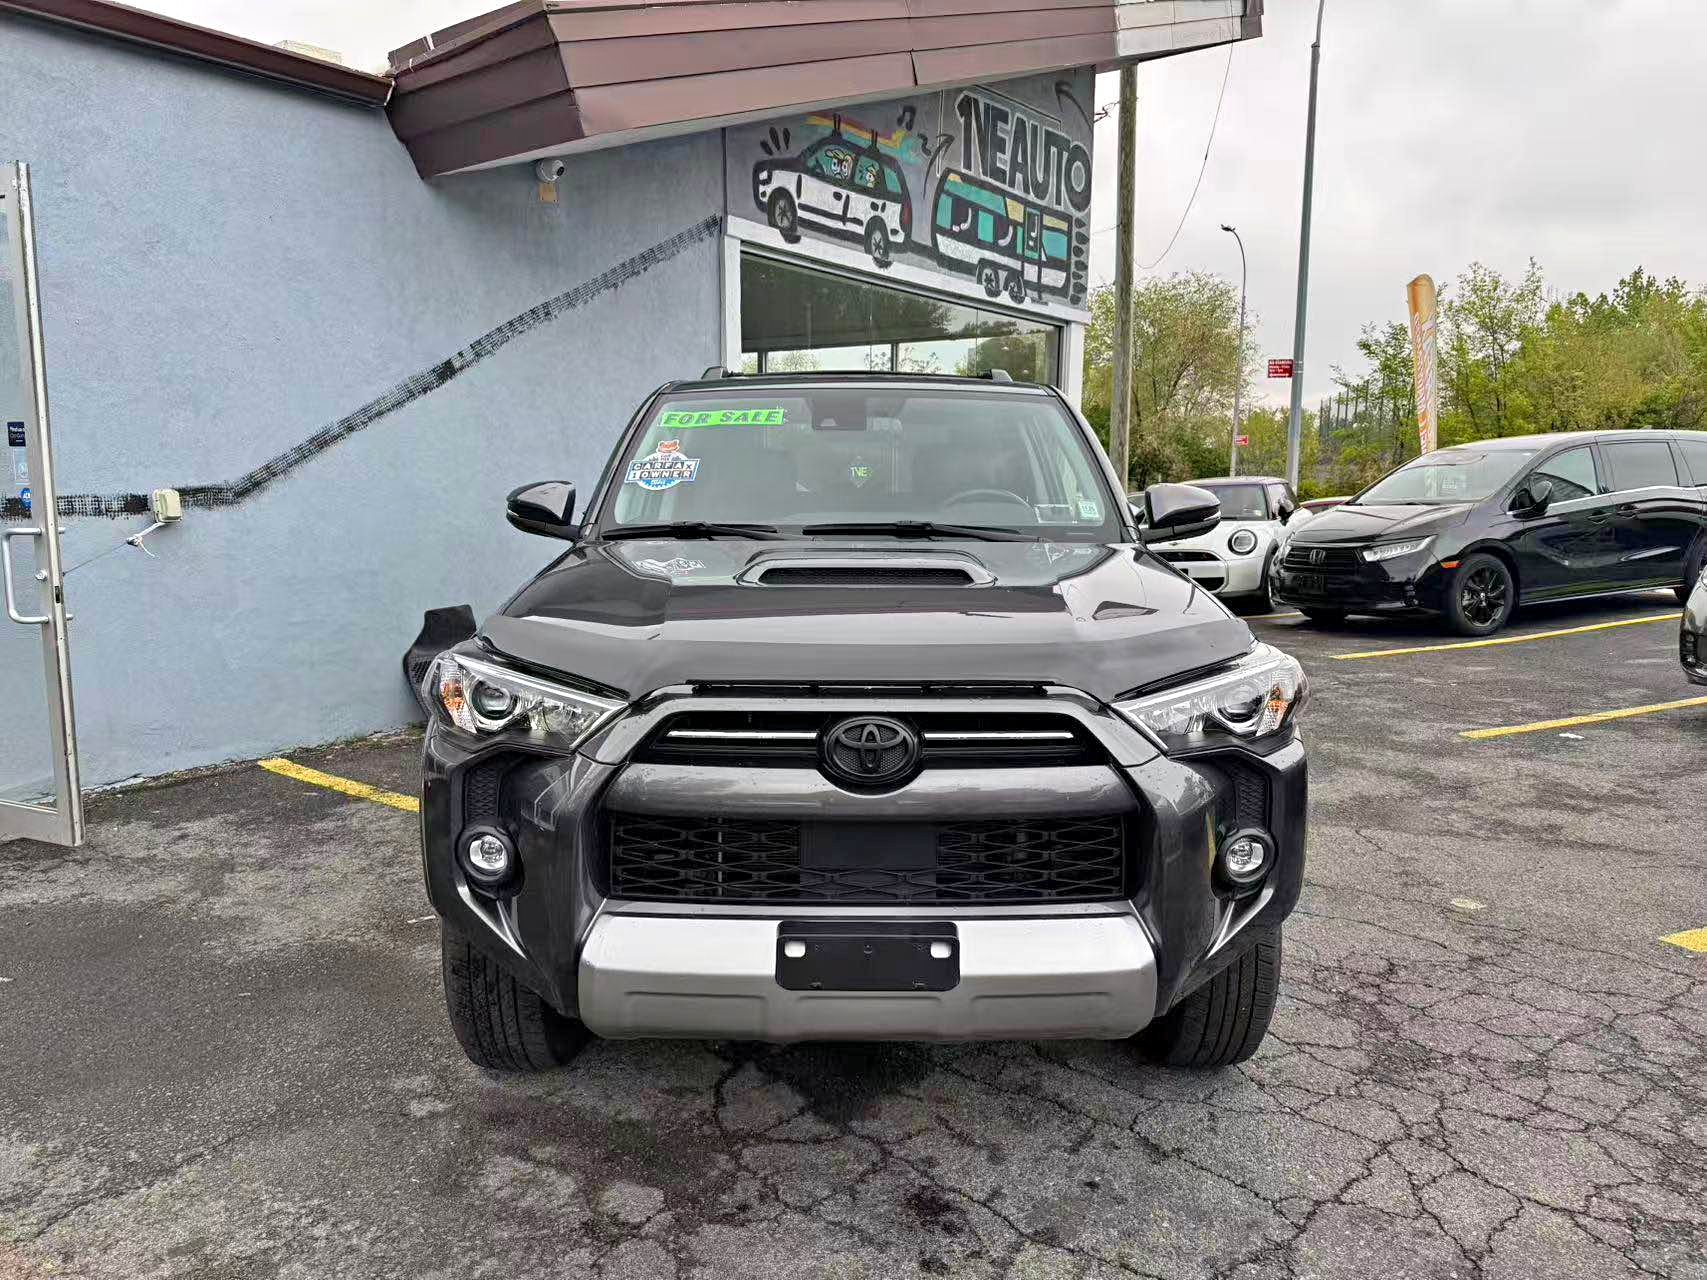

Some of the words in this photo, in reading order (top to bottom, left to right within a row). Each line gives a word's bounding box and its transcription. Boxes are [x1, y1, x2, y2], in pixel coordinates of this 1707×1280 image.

[663, 413, 711, 425] FOR
[720, 410, 780, 424] SALE
[631, 461, 694, 471] CARFAX
[640, 470, 692, 479] OWNER
